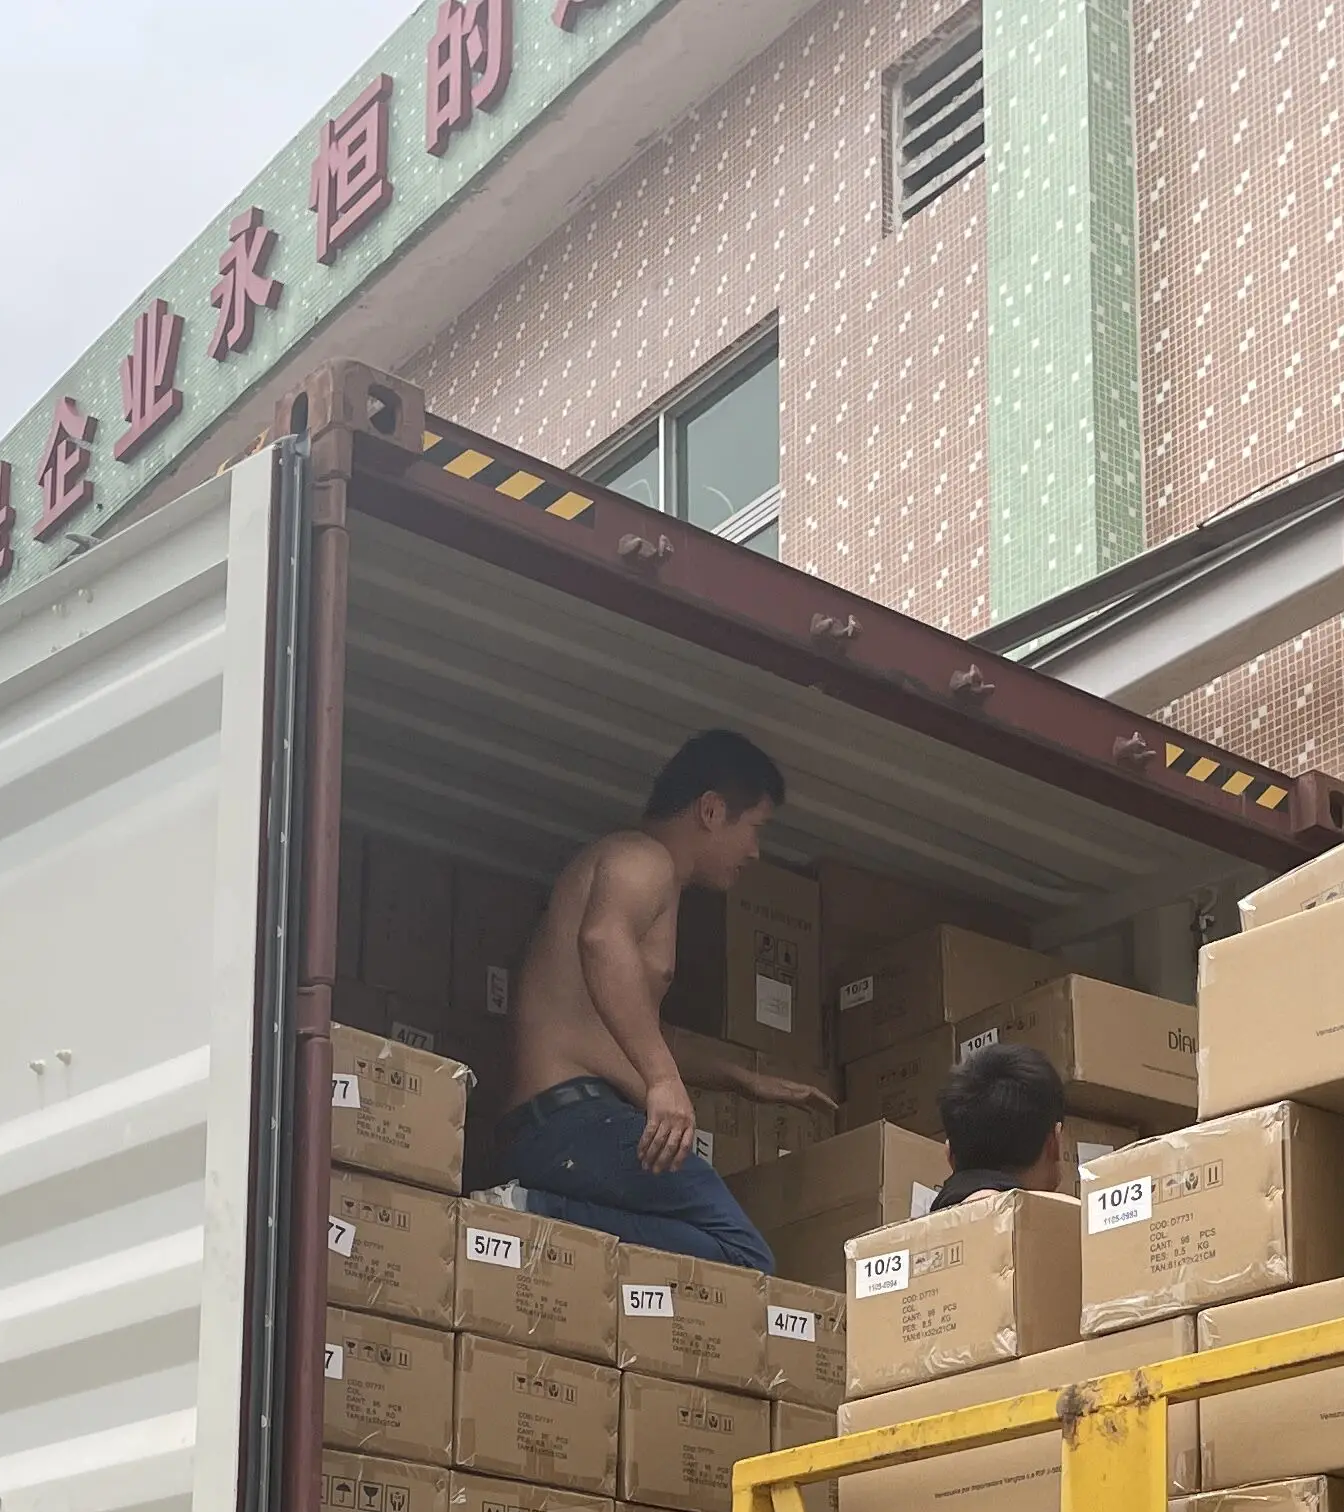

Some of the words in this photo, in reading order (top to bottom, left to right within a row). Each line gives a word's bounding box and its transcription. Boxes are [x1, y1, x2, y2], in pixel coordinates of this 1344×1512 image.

[967, 1031, 994, 1051] 10/1
[1098, 1183, 1144, 1211] 10/3
[475, 1235, 513, 1259] 5/77
[864, 1255, 902, 1278] 10/3
[630, 1290, 664, 1310] 5/77
[774, 1313, 808, 1334] 4/77
